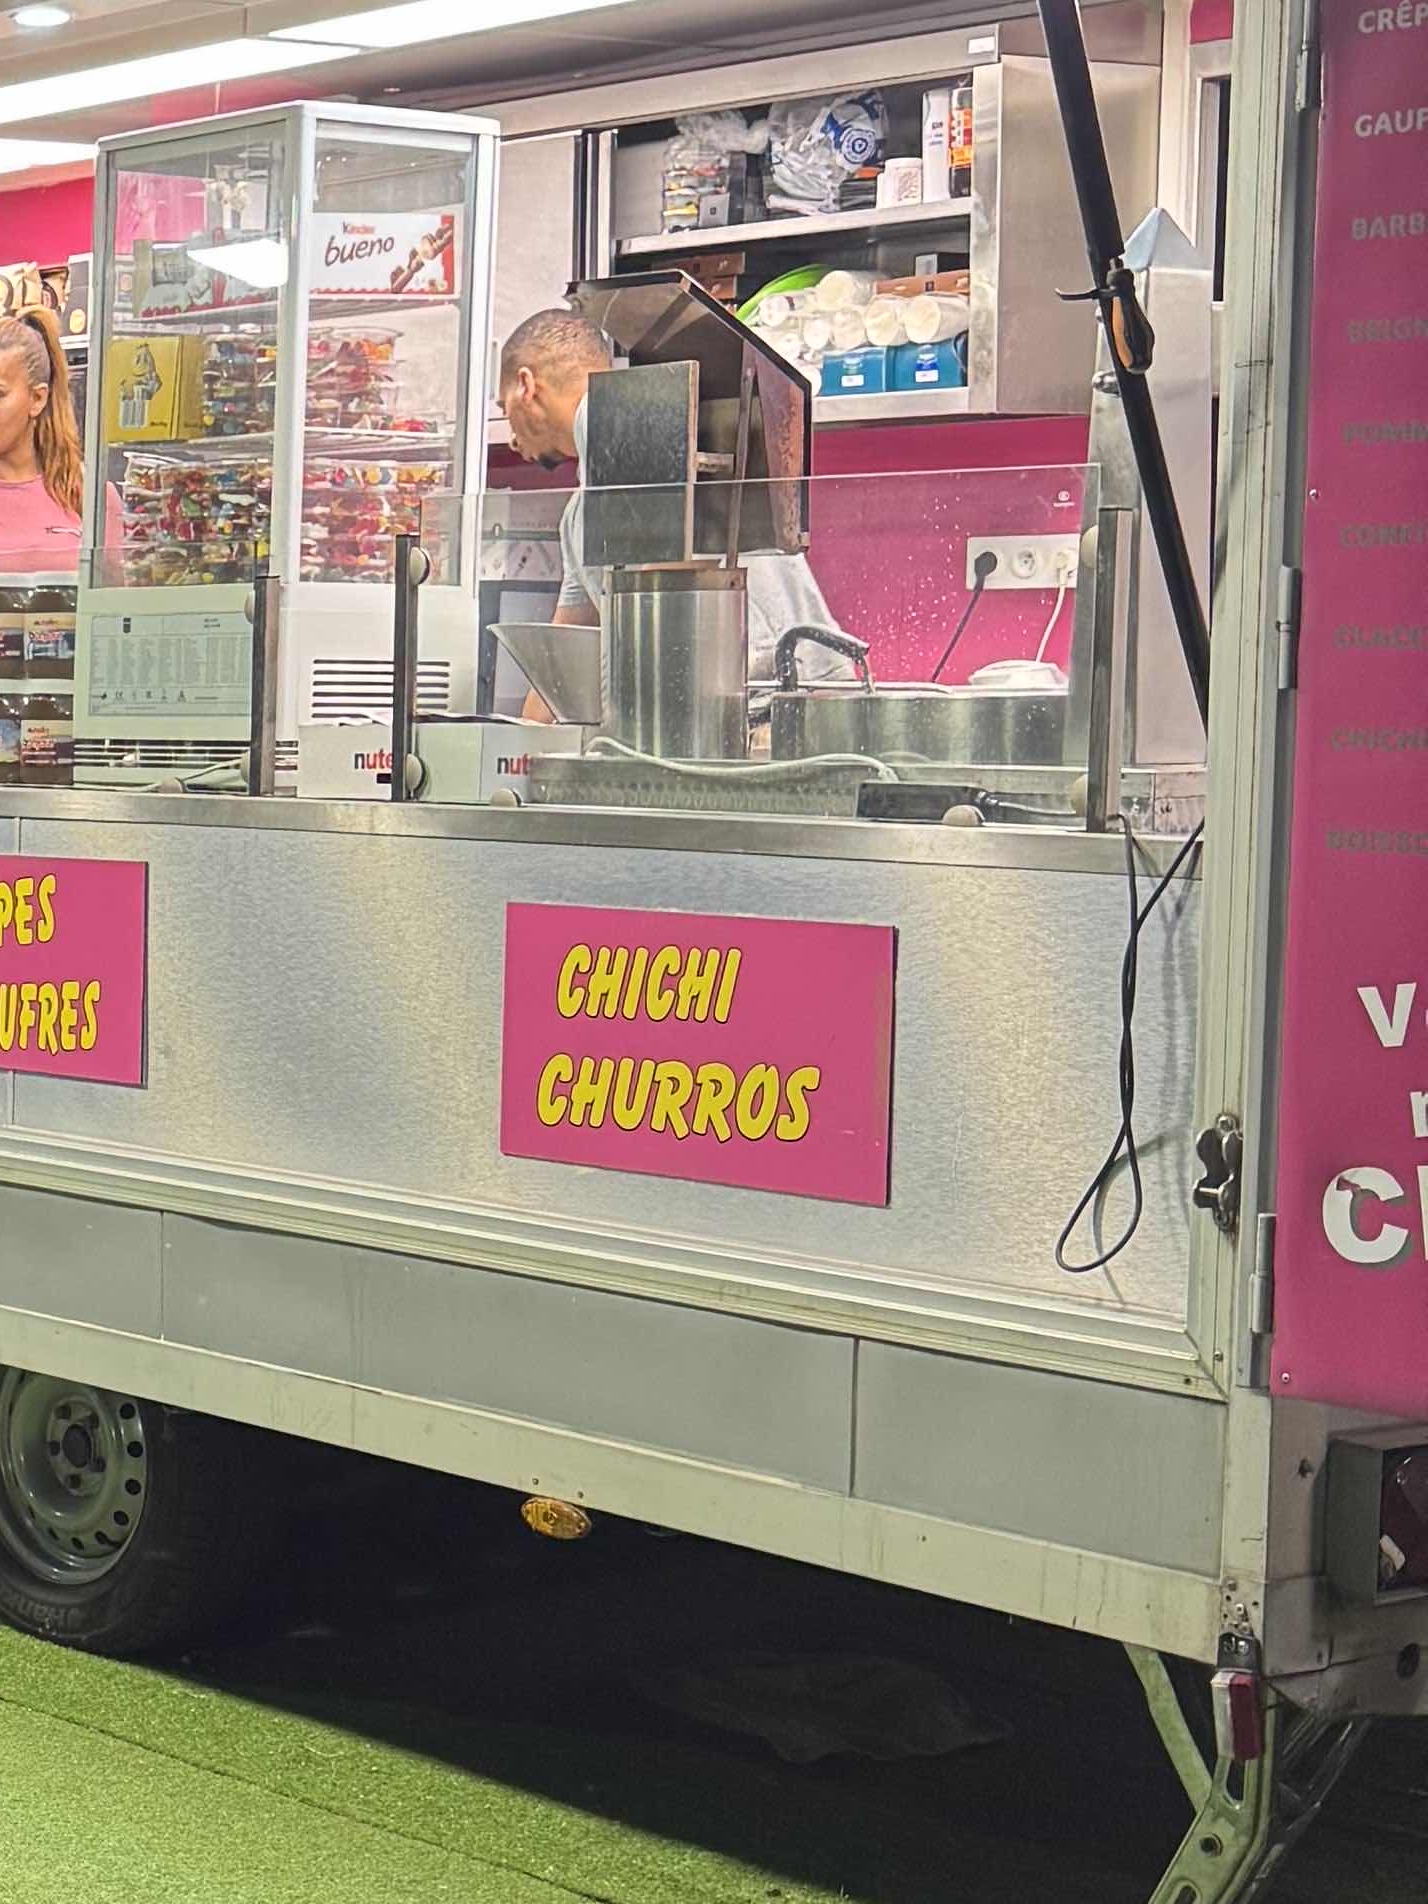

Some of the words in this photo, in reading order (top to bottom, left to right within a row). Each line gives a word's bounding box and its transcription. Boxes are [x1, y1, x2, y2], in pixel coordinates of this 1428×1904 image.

[324, 235, 394, 267] bueno
[556, 943, 743, 1023] CHICHI
[536, 1052, 821, 1143] CHURROS
